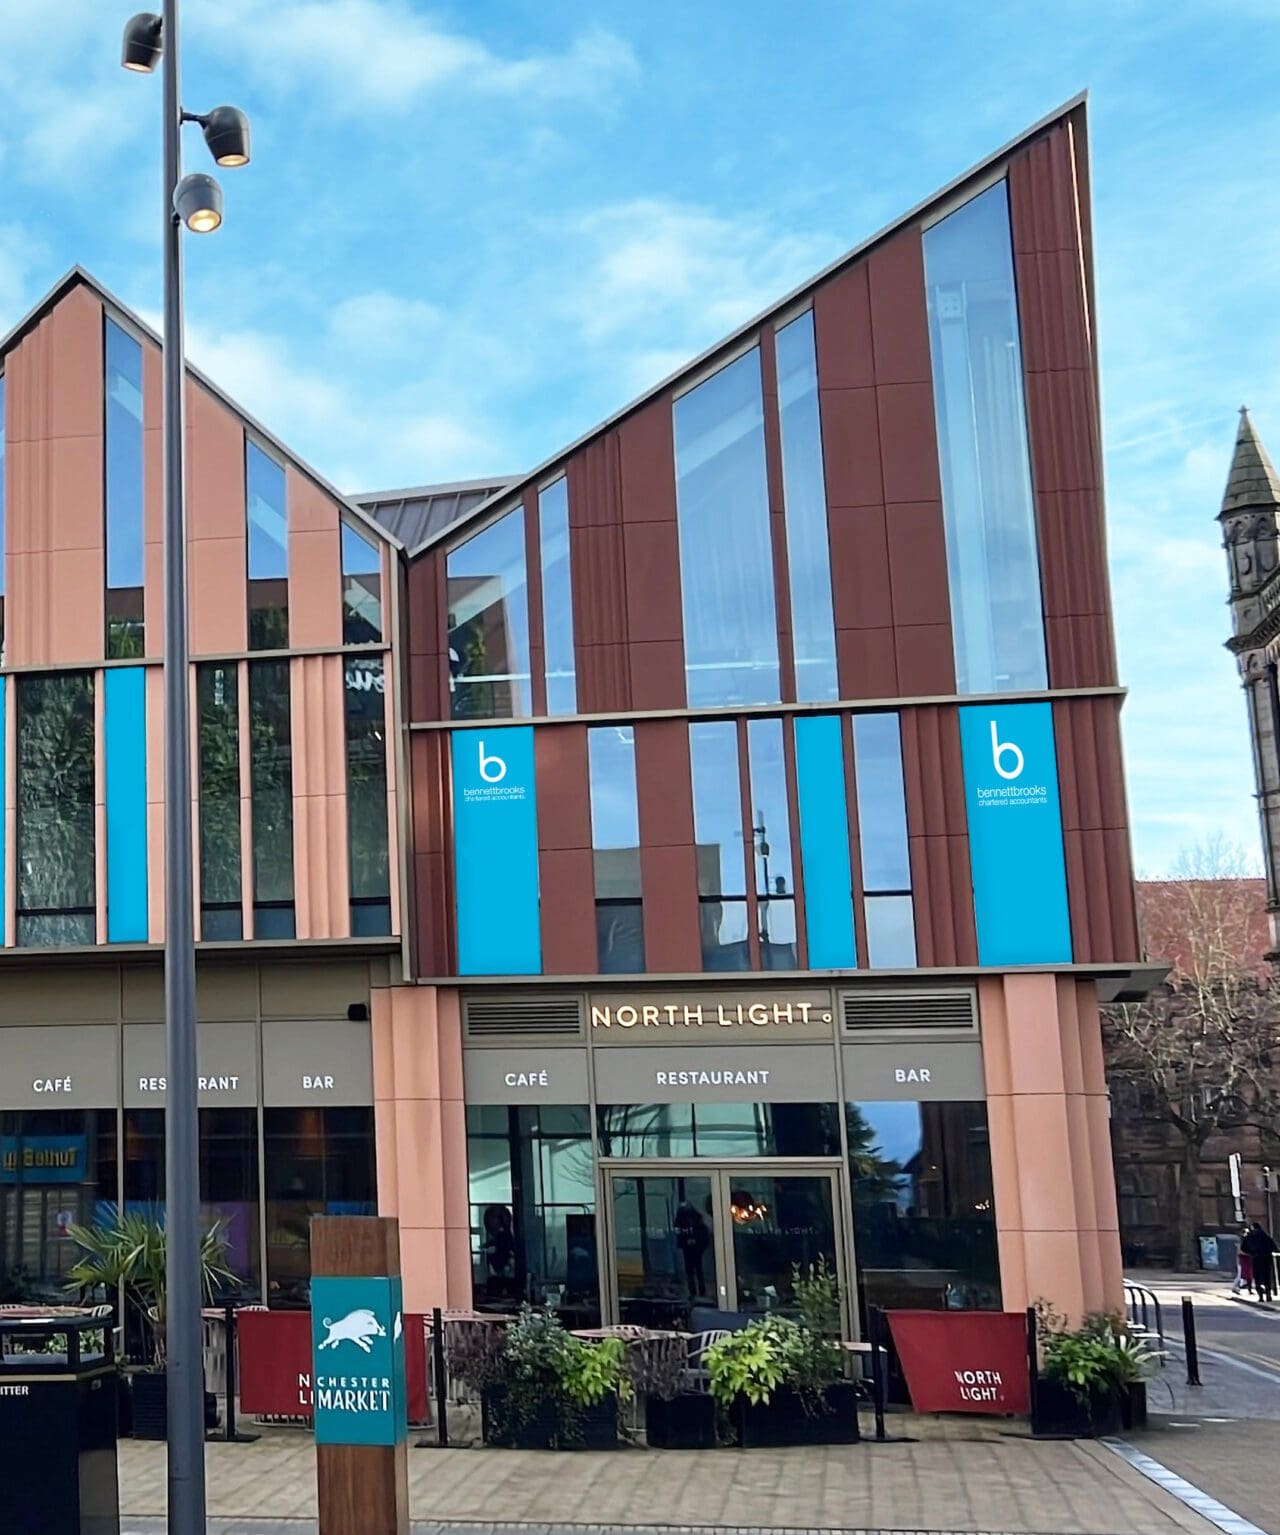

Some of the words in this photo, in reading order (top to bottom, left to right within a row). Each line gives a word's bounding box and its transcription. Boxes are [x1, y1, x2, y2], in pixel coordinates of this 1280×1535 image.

[990, 719, 1024, 780] b
[478, 740, 507, 783] b
[463, 786, 526, 796] bennettbrooks
[976, 785, 1047, 799] bennettbrooks
[591, 1004, 704, 1028] NORTH
[32, 1075, 73, 1093] CAFÉ
[139, 1076, 240, 1091] RESRANT
[302, 1075, 335, 1090] BAR
[505, 1069, 549, 1087] CAFÉ
[656, 1070, 770, 1086] RESTAURANT
[895, 1068, 932, 1084] BAR
[316, 1376, 391, 1389] CHESTER
[954, 1370, 1003, 1385] NORTH
[317, 1388, 391, 1413] MARKET
